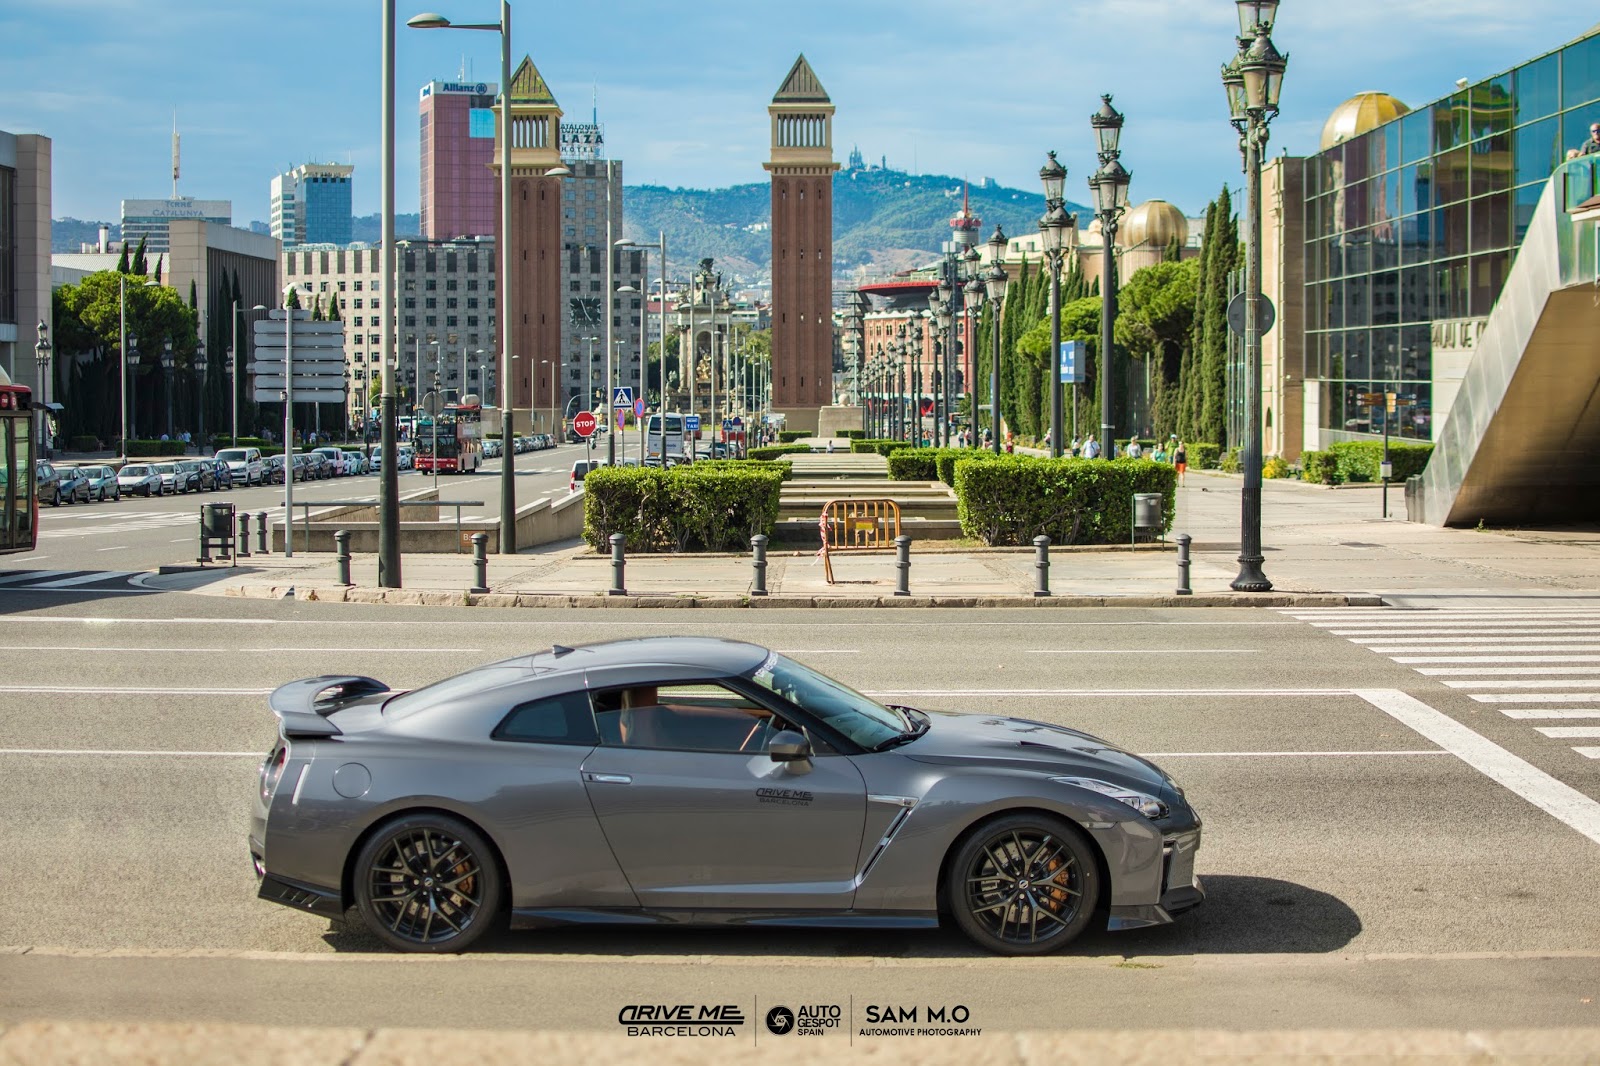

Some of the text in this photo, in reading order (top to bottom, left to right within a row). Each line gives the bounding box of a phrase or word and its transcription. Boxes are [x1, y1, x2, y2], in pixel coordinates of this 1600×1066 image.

[443, 83, 475, 92] Allianz
[562, 134, 604, 143] LAZA
[756, 788, 814, 801] DRIVE ME
[759, 798, 810, 806] BARCELONA
